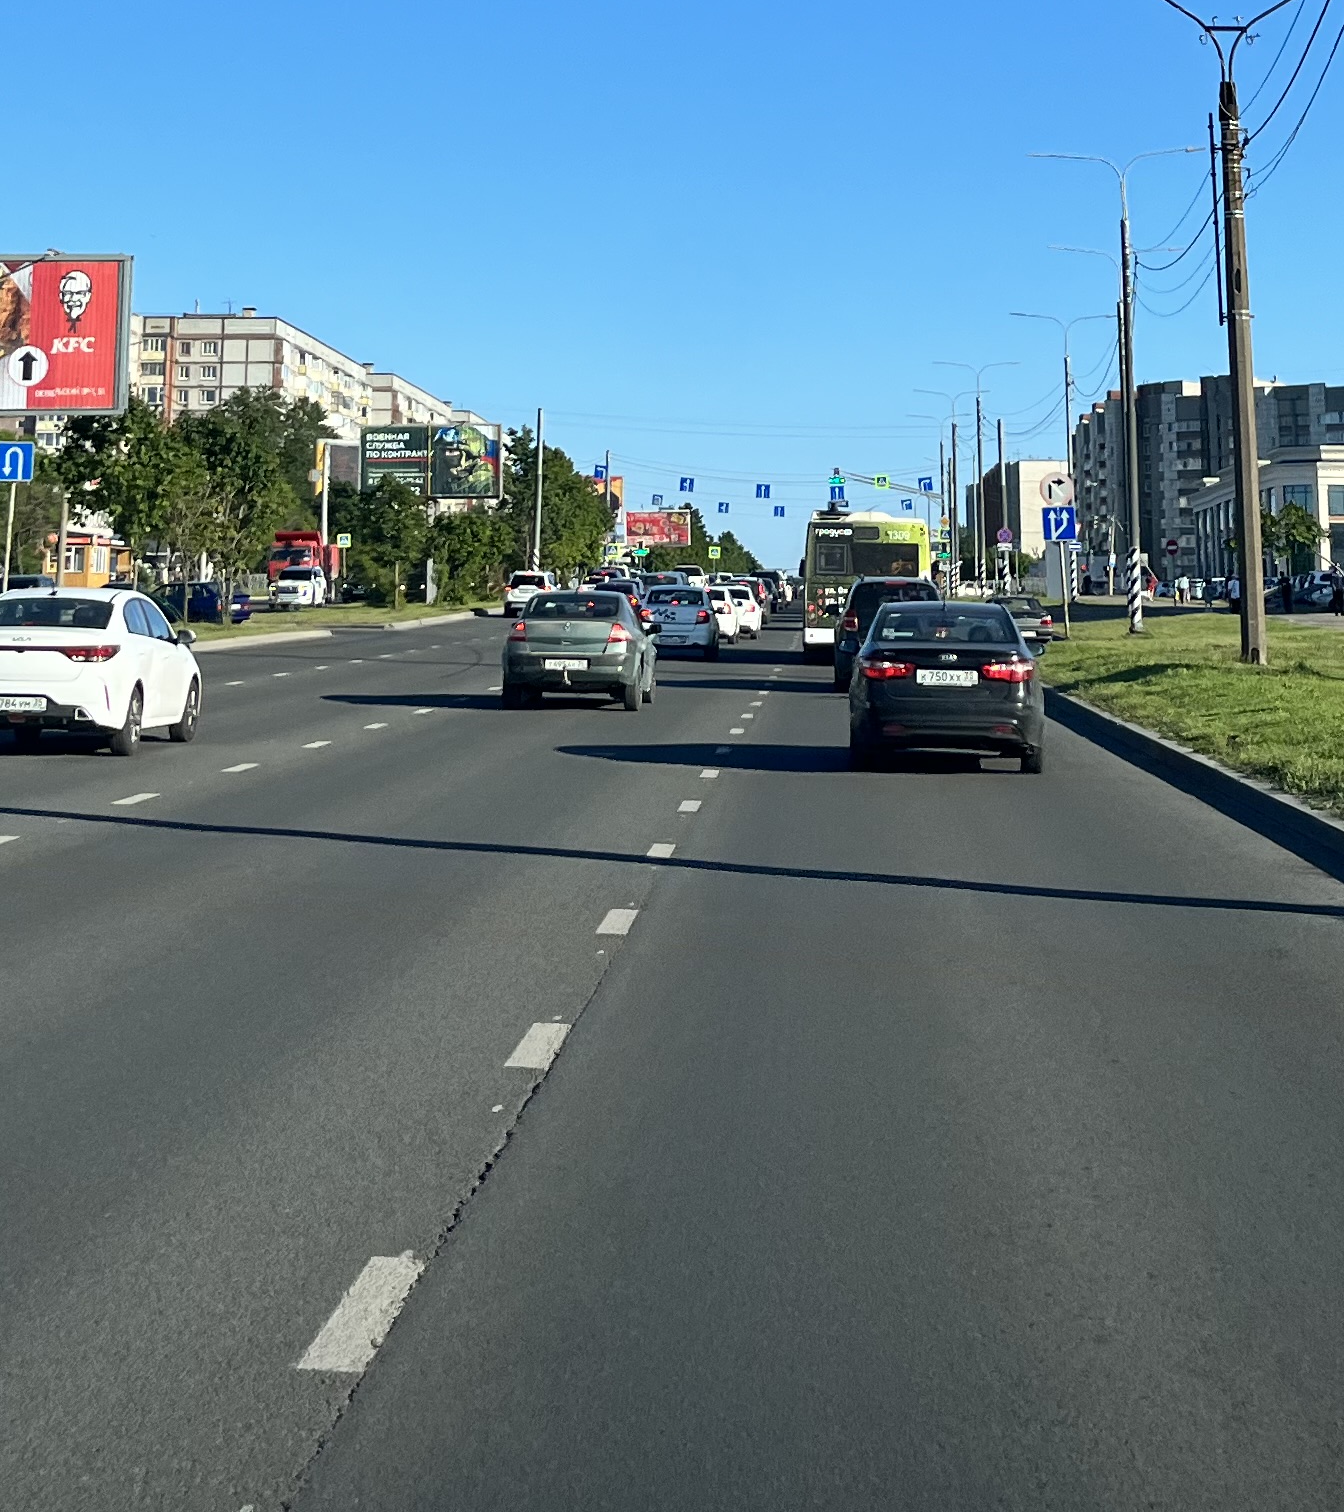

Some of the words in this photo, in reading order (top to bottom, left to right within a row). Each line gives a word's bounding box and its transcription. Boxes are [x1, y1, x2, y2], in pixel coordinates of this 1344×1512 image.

[50, 337, 95, 354] KFC
[366, 432, 410, 441] ВОЕННАЯ
[366, 441, 405, 450] СЛУЖБА
[366, 450, 380, 458] ПО
